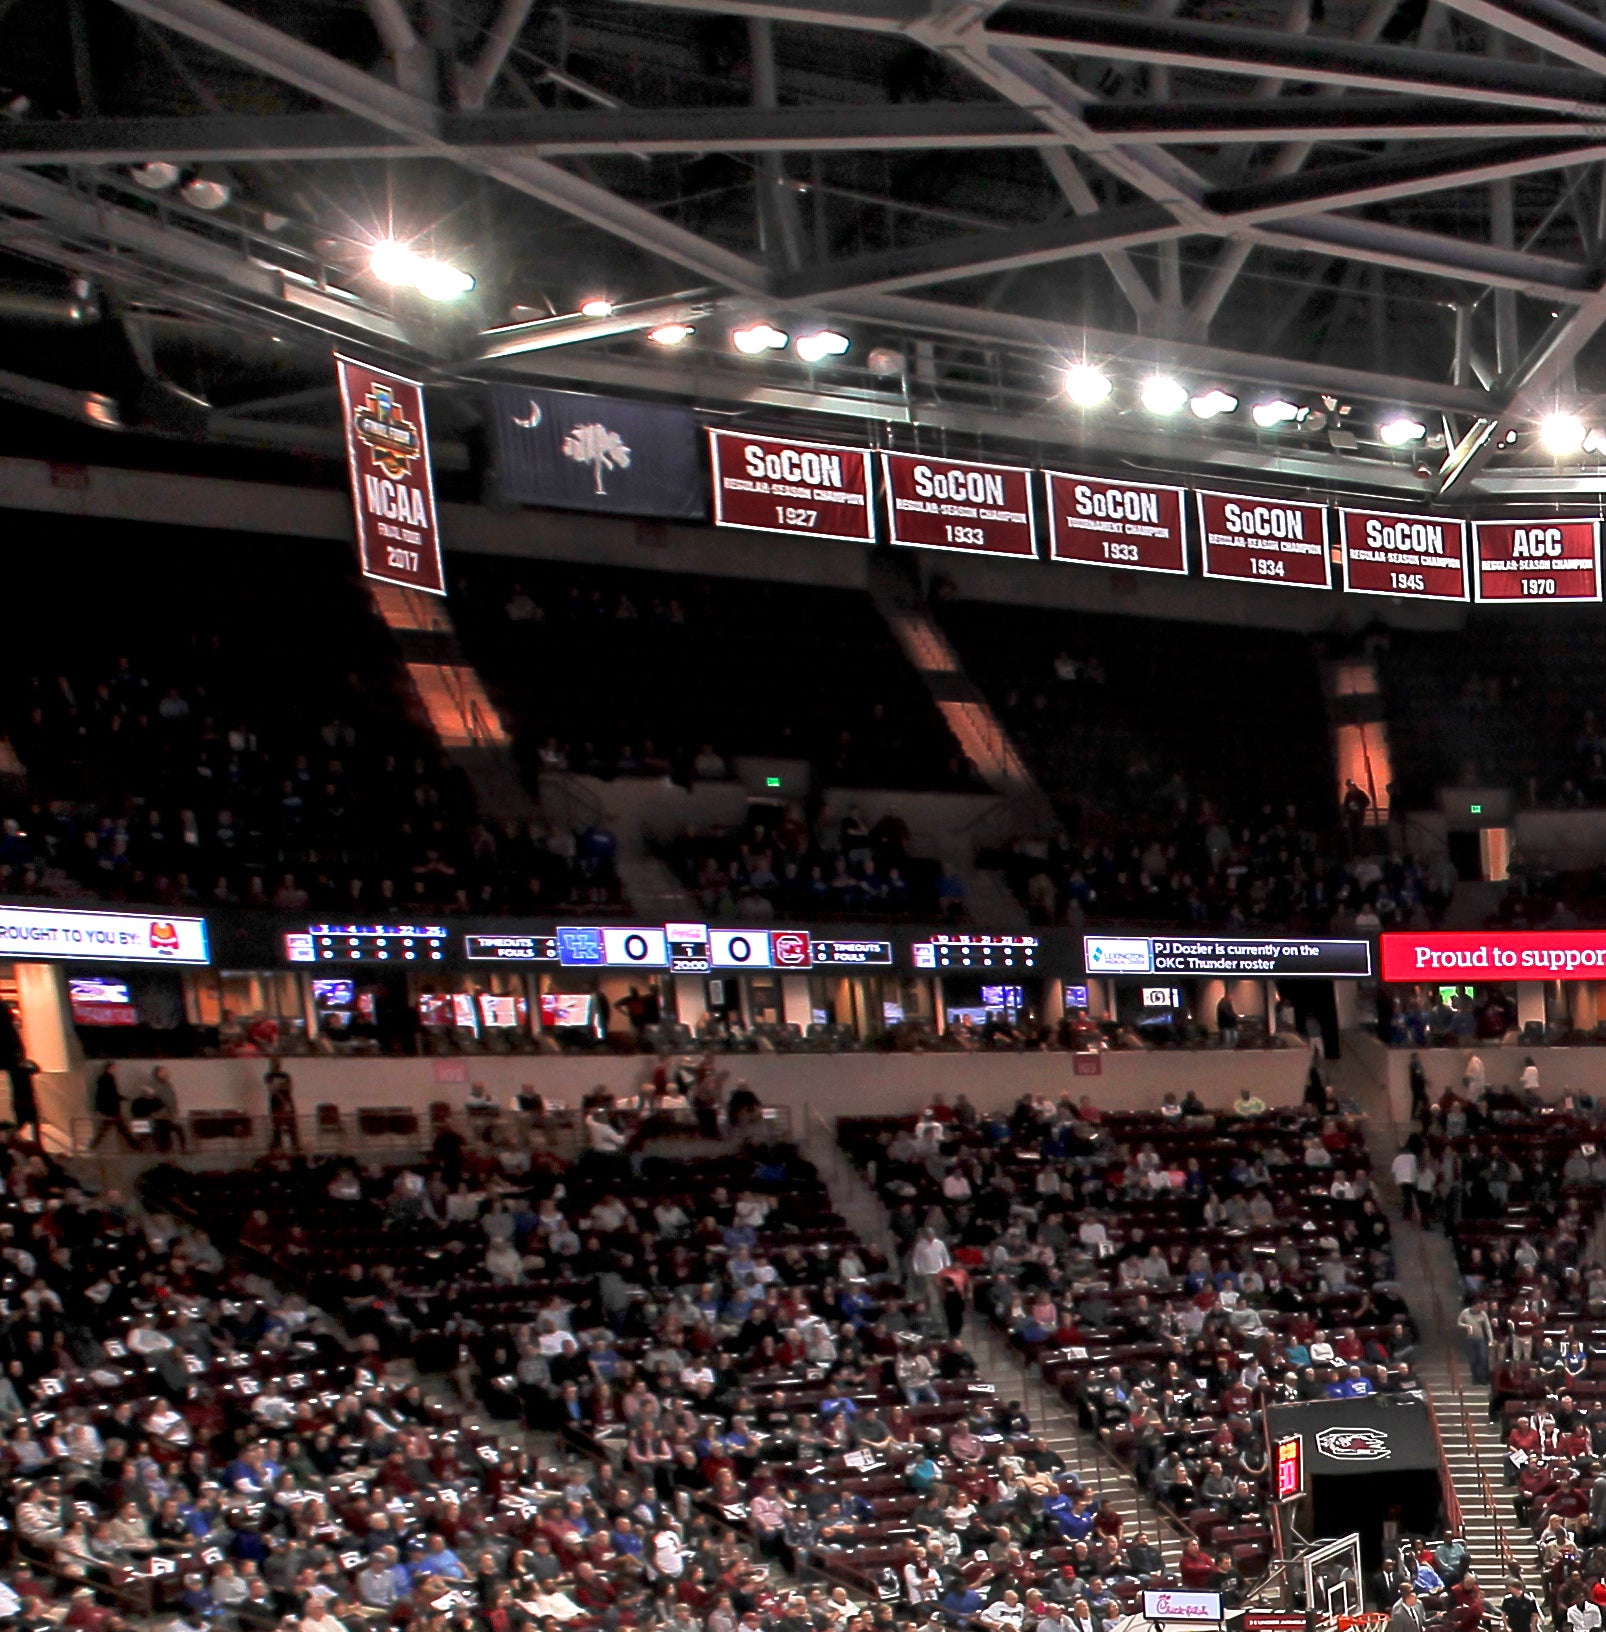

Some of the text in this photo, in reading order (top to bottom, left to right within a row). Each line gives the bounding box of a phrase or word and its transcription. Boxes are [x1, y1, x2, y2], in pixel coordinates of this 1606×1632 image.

[744, 444, 844, 488] SoCON
[913, 464, 1005, 506] SoCON
[364, 473, 429, 529] NCAA
[1074, 485, 1160, 524] SoCON
[775, 506, 818, 527] 1927
[1224, 503, 1304, 540] SoCON
[945, 524, 984, 545] 1933
[1366, 519, 1444, 554] SoCON
[1512, 528, 1562, 557] ACC
[386, 546, 419, 572] 2017
[1101, 541, 1139, 561] 1933
[1250, 557, 1285, 577] 1934
[1390, 572, 1424, 590] 1945
[1521, 578, 1555, 595] 1970
[0, 925, 116, 944] ROUGHT TO YOU
[623, 934, 648, 961] 0
[728, 936, 751, 962] 0
[1154, 942, 1320, 959] PJ Dozier is currently on the
[1415, 945, 1488, 968] Proud
[1494, 947, 1518, 967] to
[1155, 957, 1185, 969] OKC
[1187, 957, 1237, 969] Thunder
[1239, 958, 1275, 970] roster
